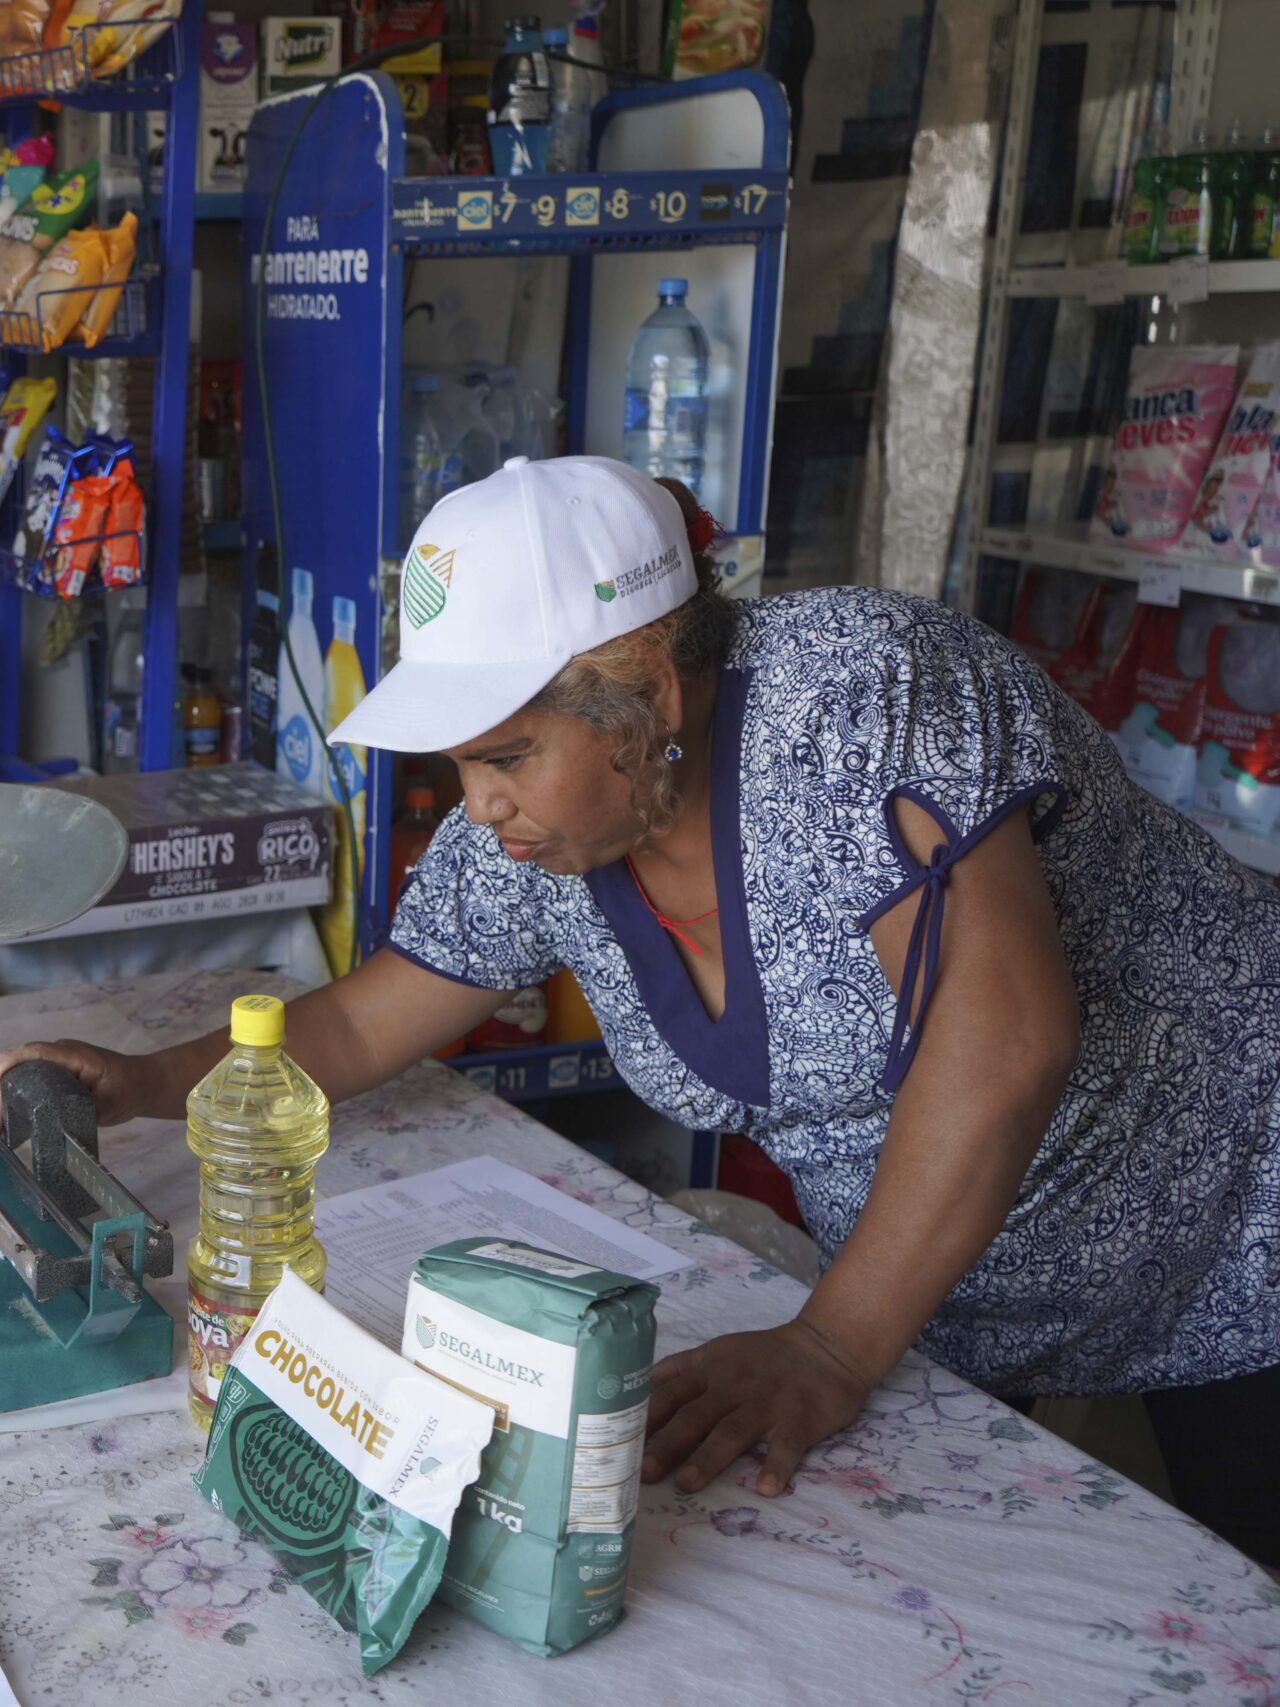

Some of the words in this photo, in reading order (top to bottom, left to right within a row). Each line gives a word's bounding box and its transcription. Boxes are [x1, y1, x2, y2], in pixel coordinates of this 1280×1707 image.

[531, 195, 556, 223] $9
[605, 191, 629, 220] $8
[650, 191, 687, 218] $10
[735, 188, 769, 215] $17
[616, 544, 680, 590] SEGALMEX
[133, 832, 235, 875] HERSHEY'S
[261, 834, 314, 861] RICO
[188, 1307, 230, 1348] oya
[212, 1315, 225, 1327] de
[439, 1331, 545, 1387] SEGALMEX
[255, 1329, 395, 1460] CHOCOLATE
[389, 1415, 439, 1497] SEGALMEX
